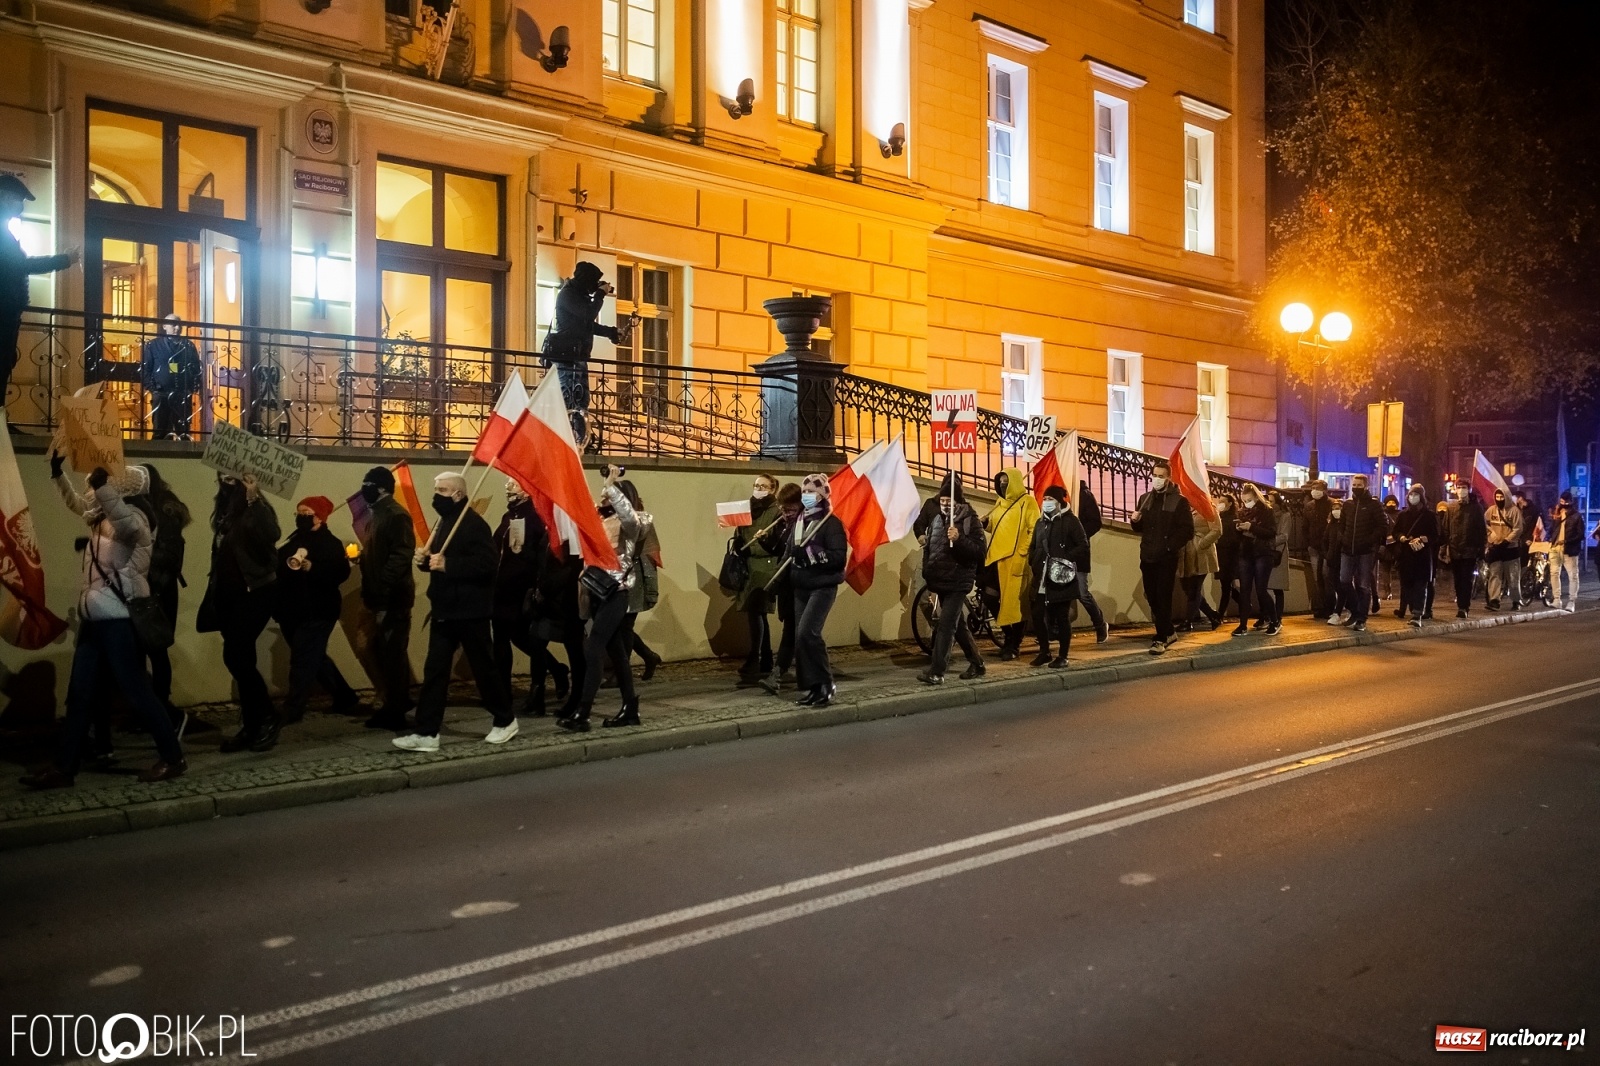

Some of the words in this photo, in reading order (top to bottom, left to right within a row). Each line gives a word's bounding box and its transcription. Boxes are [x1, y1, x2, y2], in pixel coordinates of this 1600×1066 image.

[311, 183, 340, 191] Raciborzu
[312, 176, 345, 185] REJONOWY
[934, 393, 976, 412] WOLNA
[1030, 416, 1052, 435] PIS
[216, 422, 252, 448] JAREK
[254, 439, 270, 454] TO
[273, 447, 304, 472] TWOJA
[935, 430, 975, 450] POLKA
[206, 447, 245, 472] WIELKA
[211, 434, 238, 455] WINA
[243, 448, 273, 473] TWOJA
